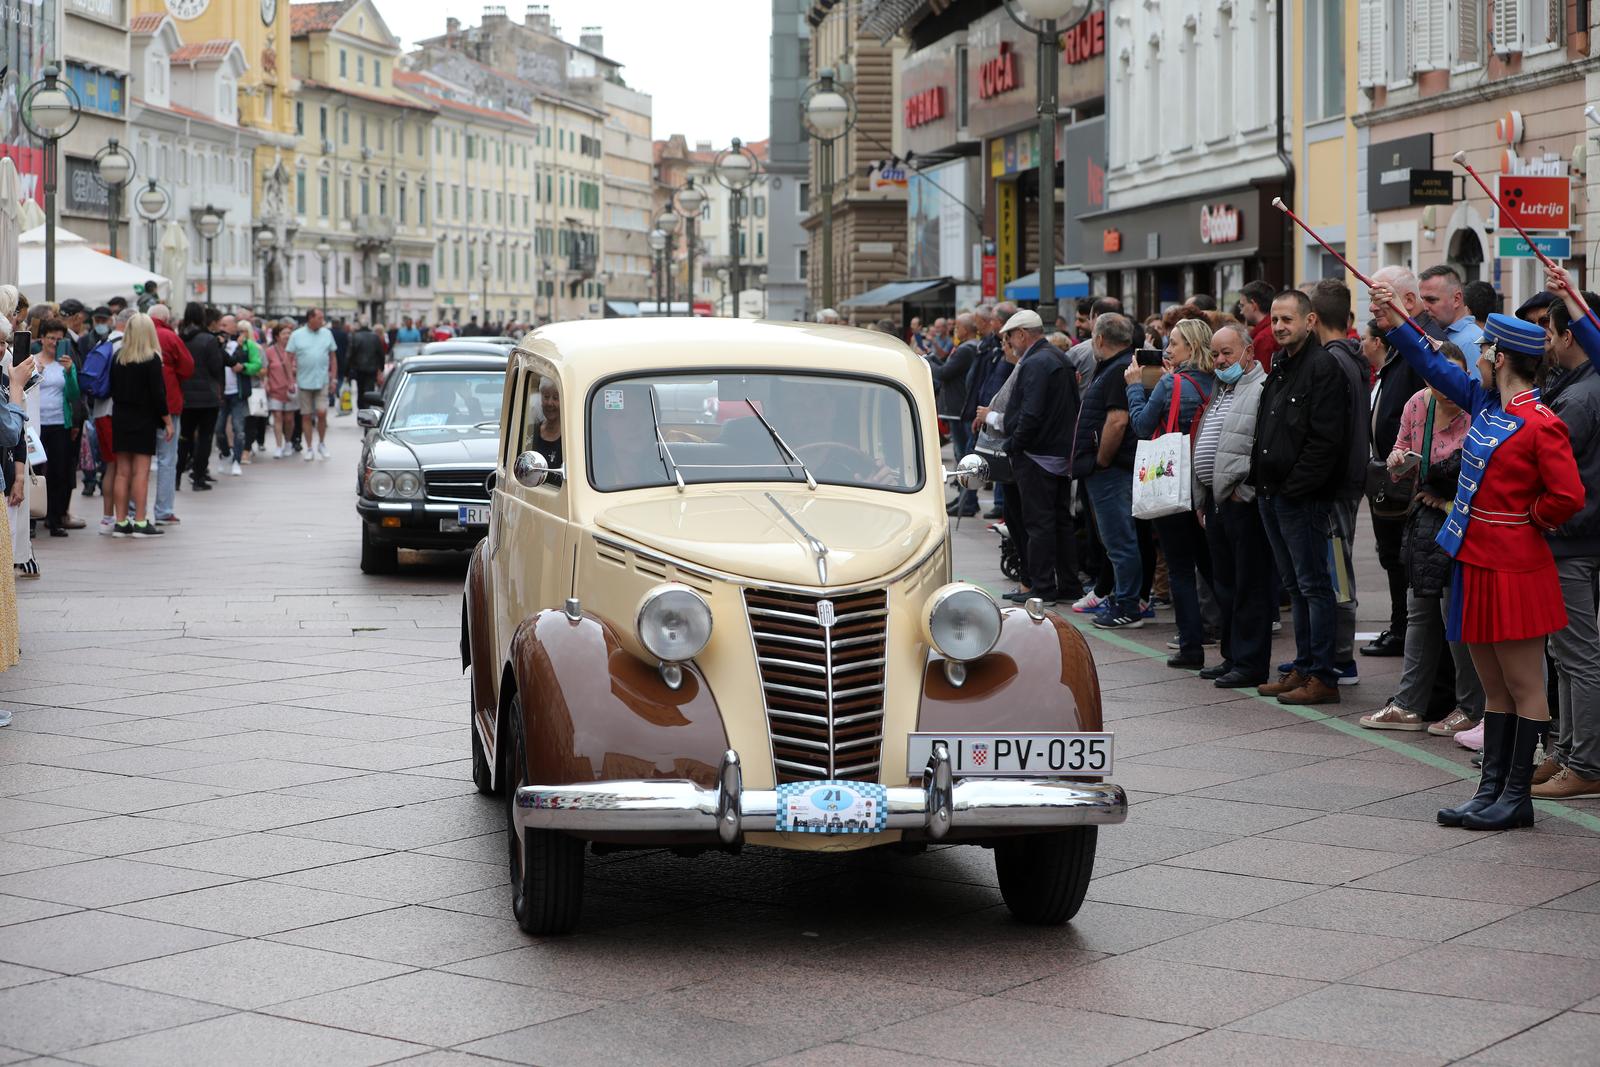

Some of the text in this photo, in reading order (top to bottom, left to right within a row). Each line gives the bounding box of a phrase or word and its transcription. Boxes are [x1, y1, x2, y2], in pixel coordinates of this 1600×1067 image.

[1520, 202, 1564, 218] Lutrija
[468, 509, 482, 522] RI
[994, 739, 1106, 770] PV-035
